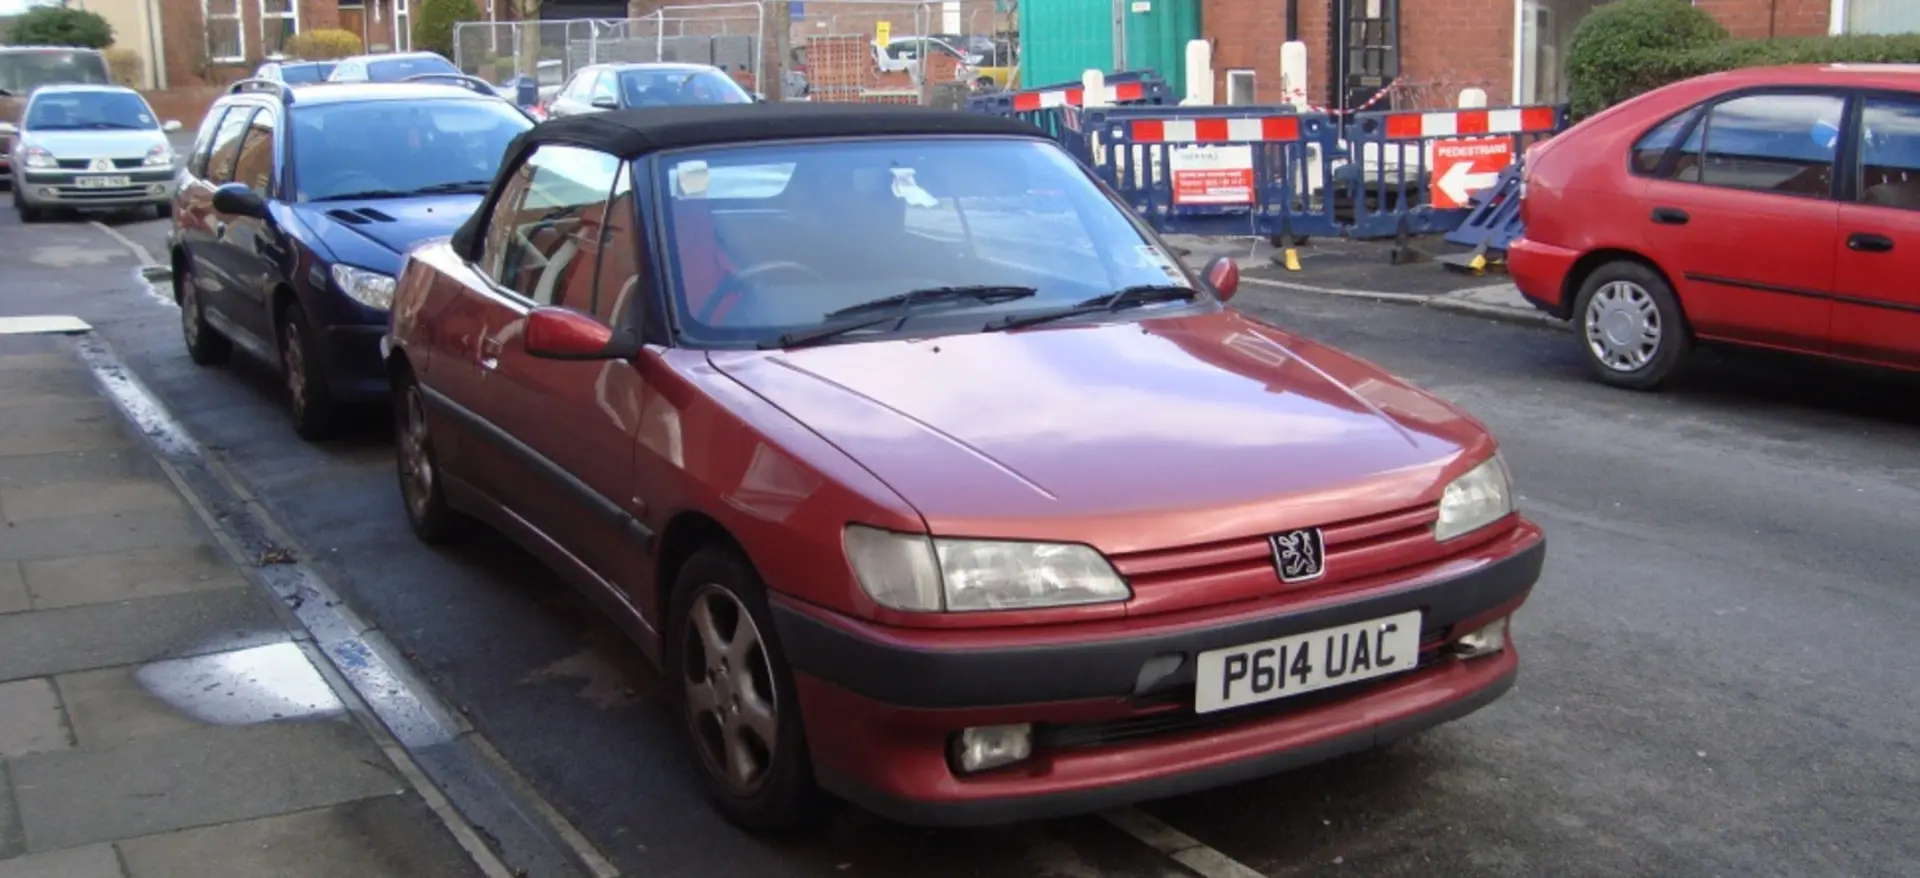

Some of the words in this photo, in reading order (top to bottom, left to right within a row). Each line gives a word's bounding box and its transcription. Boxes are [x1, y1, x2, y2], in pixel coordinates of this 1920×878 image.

[1438, 143, 1507, 157] PEDESTRIANS
[1222, 641, 1312, 701] P614
[1325, 623, 1398, 679] UAC
